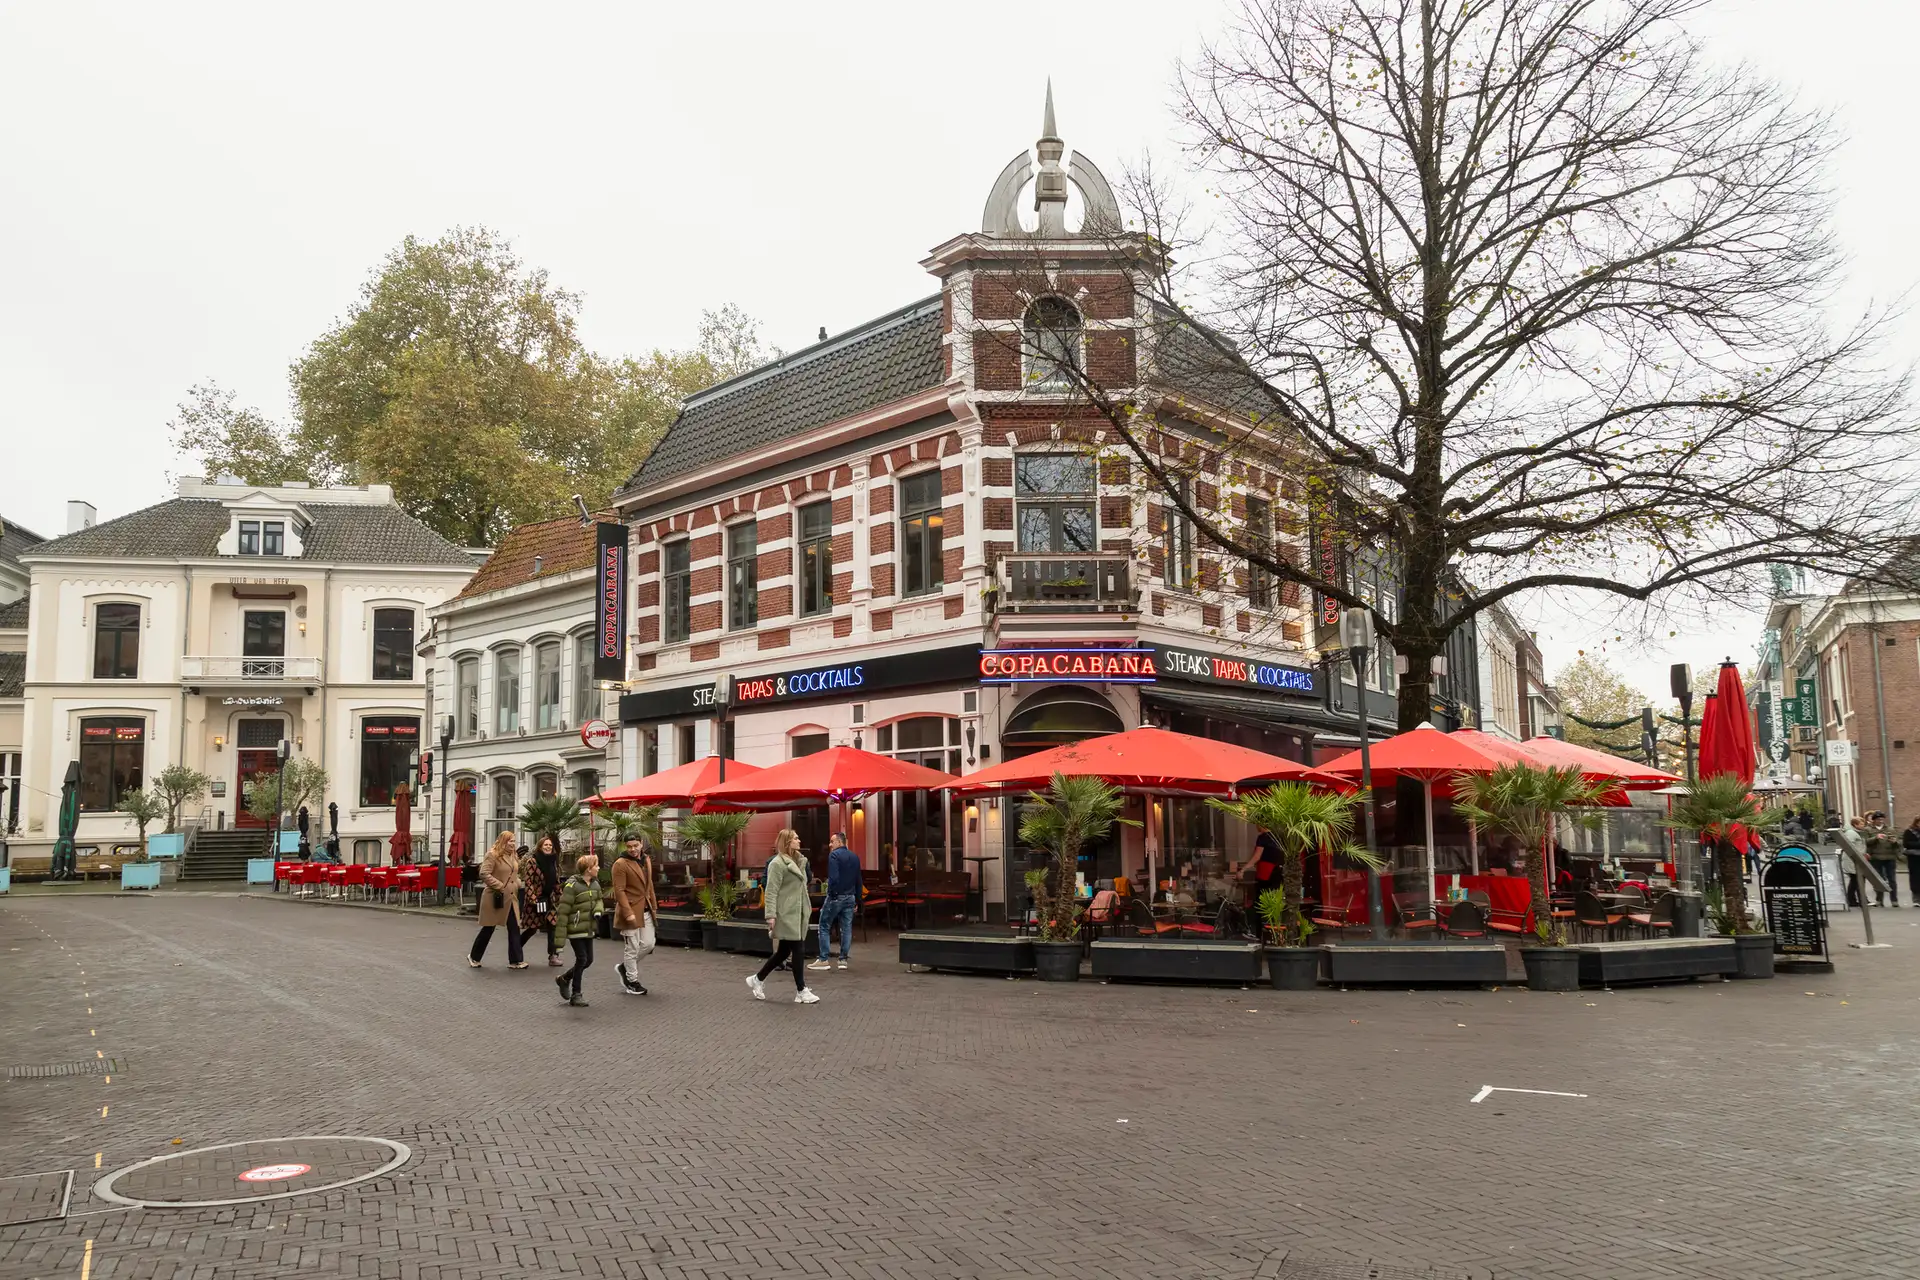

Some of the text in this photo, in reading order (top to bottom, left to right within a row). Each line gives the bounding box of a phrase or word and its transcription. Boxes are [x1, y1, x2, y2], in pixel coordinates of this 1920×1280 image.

[604, 545, 618, 658] COPACABANA
[980, 654, 1157, 676] COPACABANA
[1165, 650, 1313, 691] STEAKS TAPAS & COCKTAILS
[692, 666, 863, 706] STEA TAPAS & COCKTAILS
